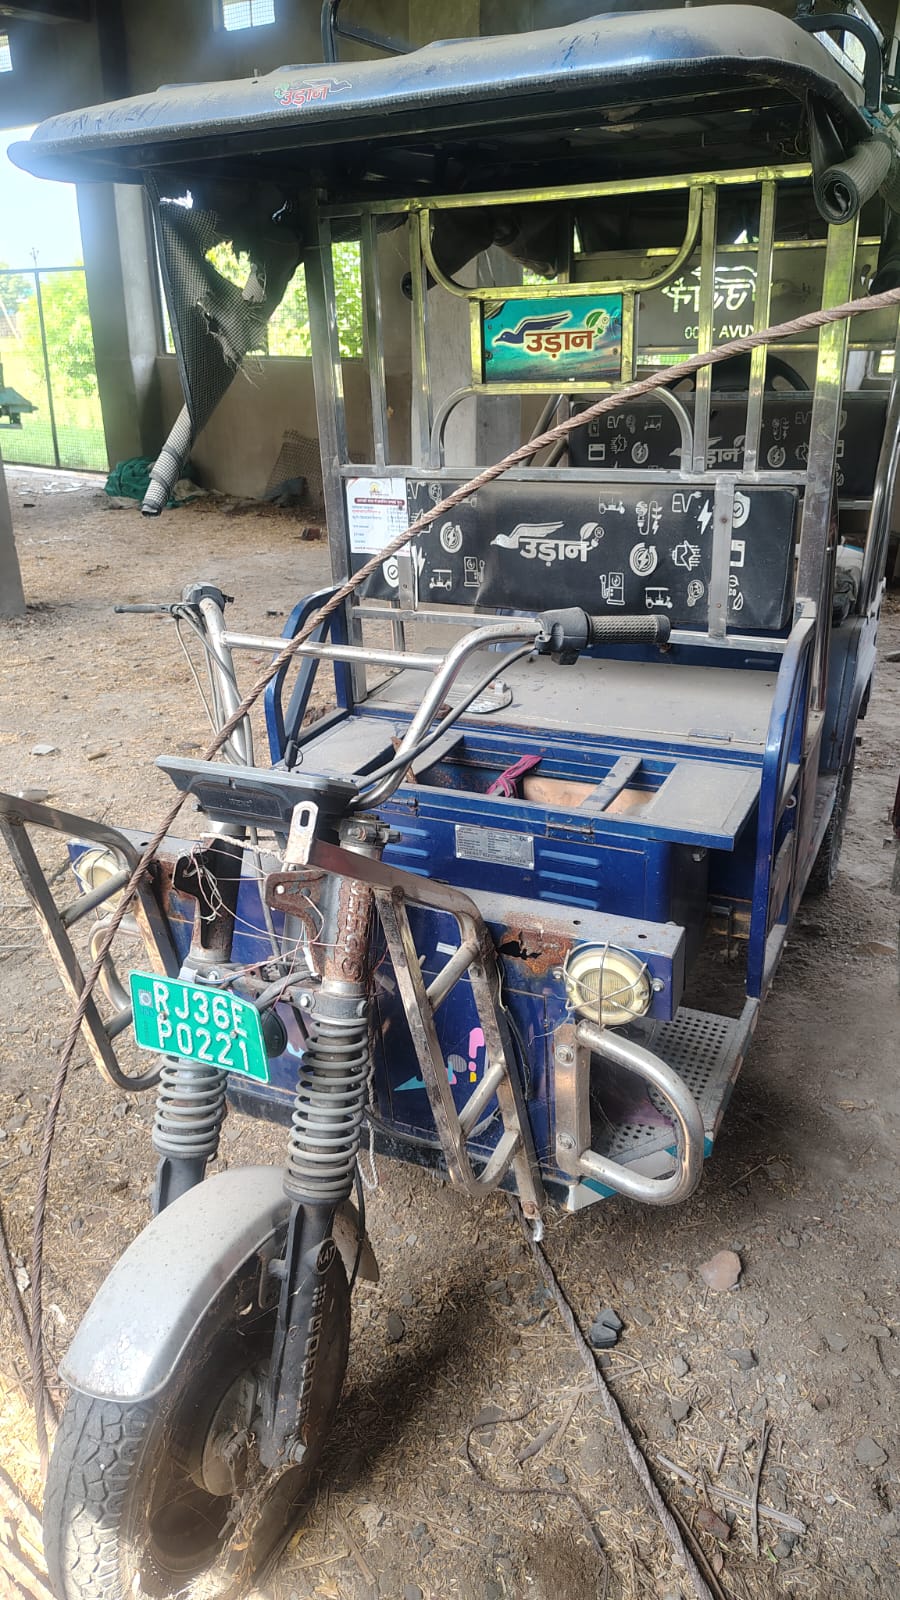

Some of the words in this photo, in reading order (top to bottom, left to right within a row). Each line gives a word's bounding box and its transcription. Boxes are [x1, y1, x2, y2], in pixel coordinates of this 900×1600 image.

[525, 330, 595, 359] उड़ान
[671, 493, 694, 513] EV
[519, 538, 591, 567] उड़ान
[153, 981, 248, 1040] RJ36E
[156, 1012, 249, 1072] P0221
